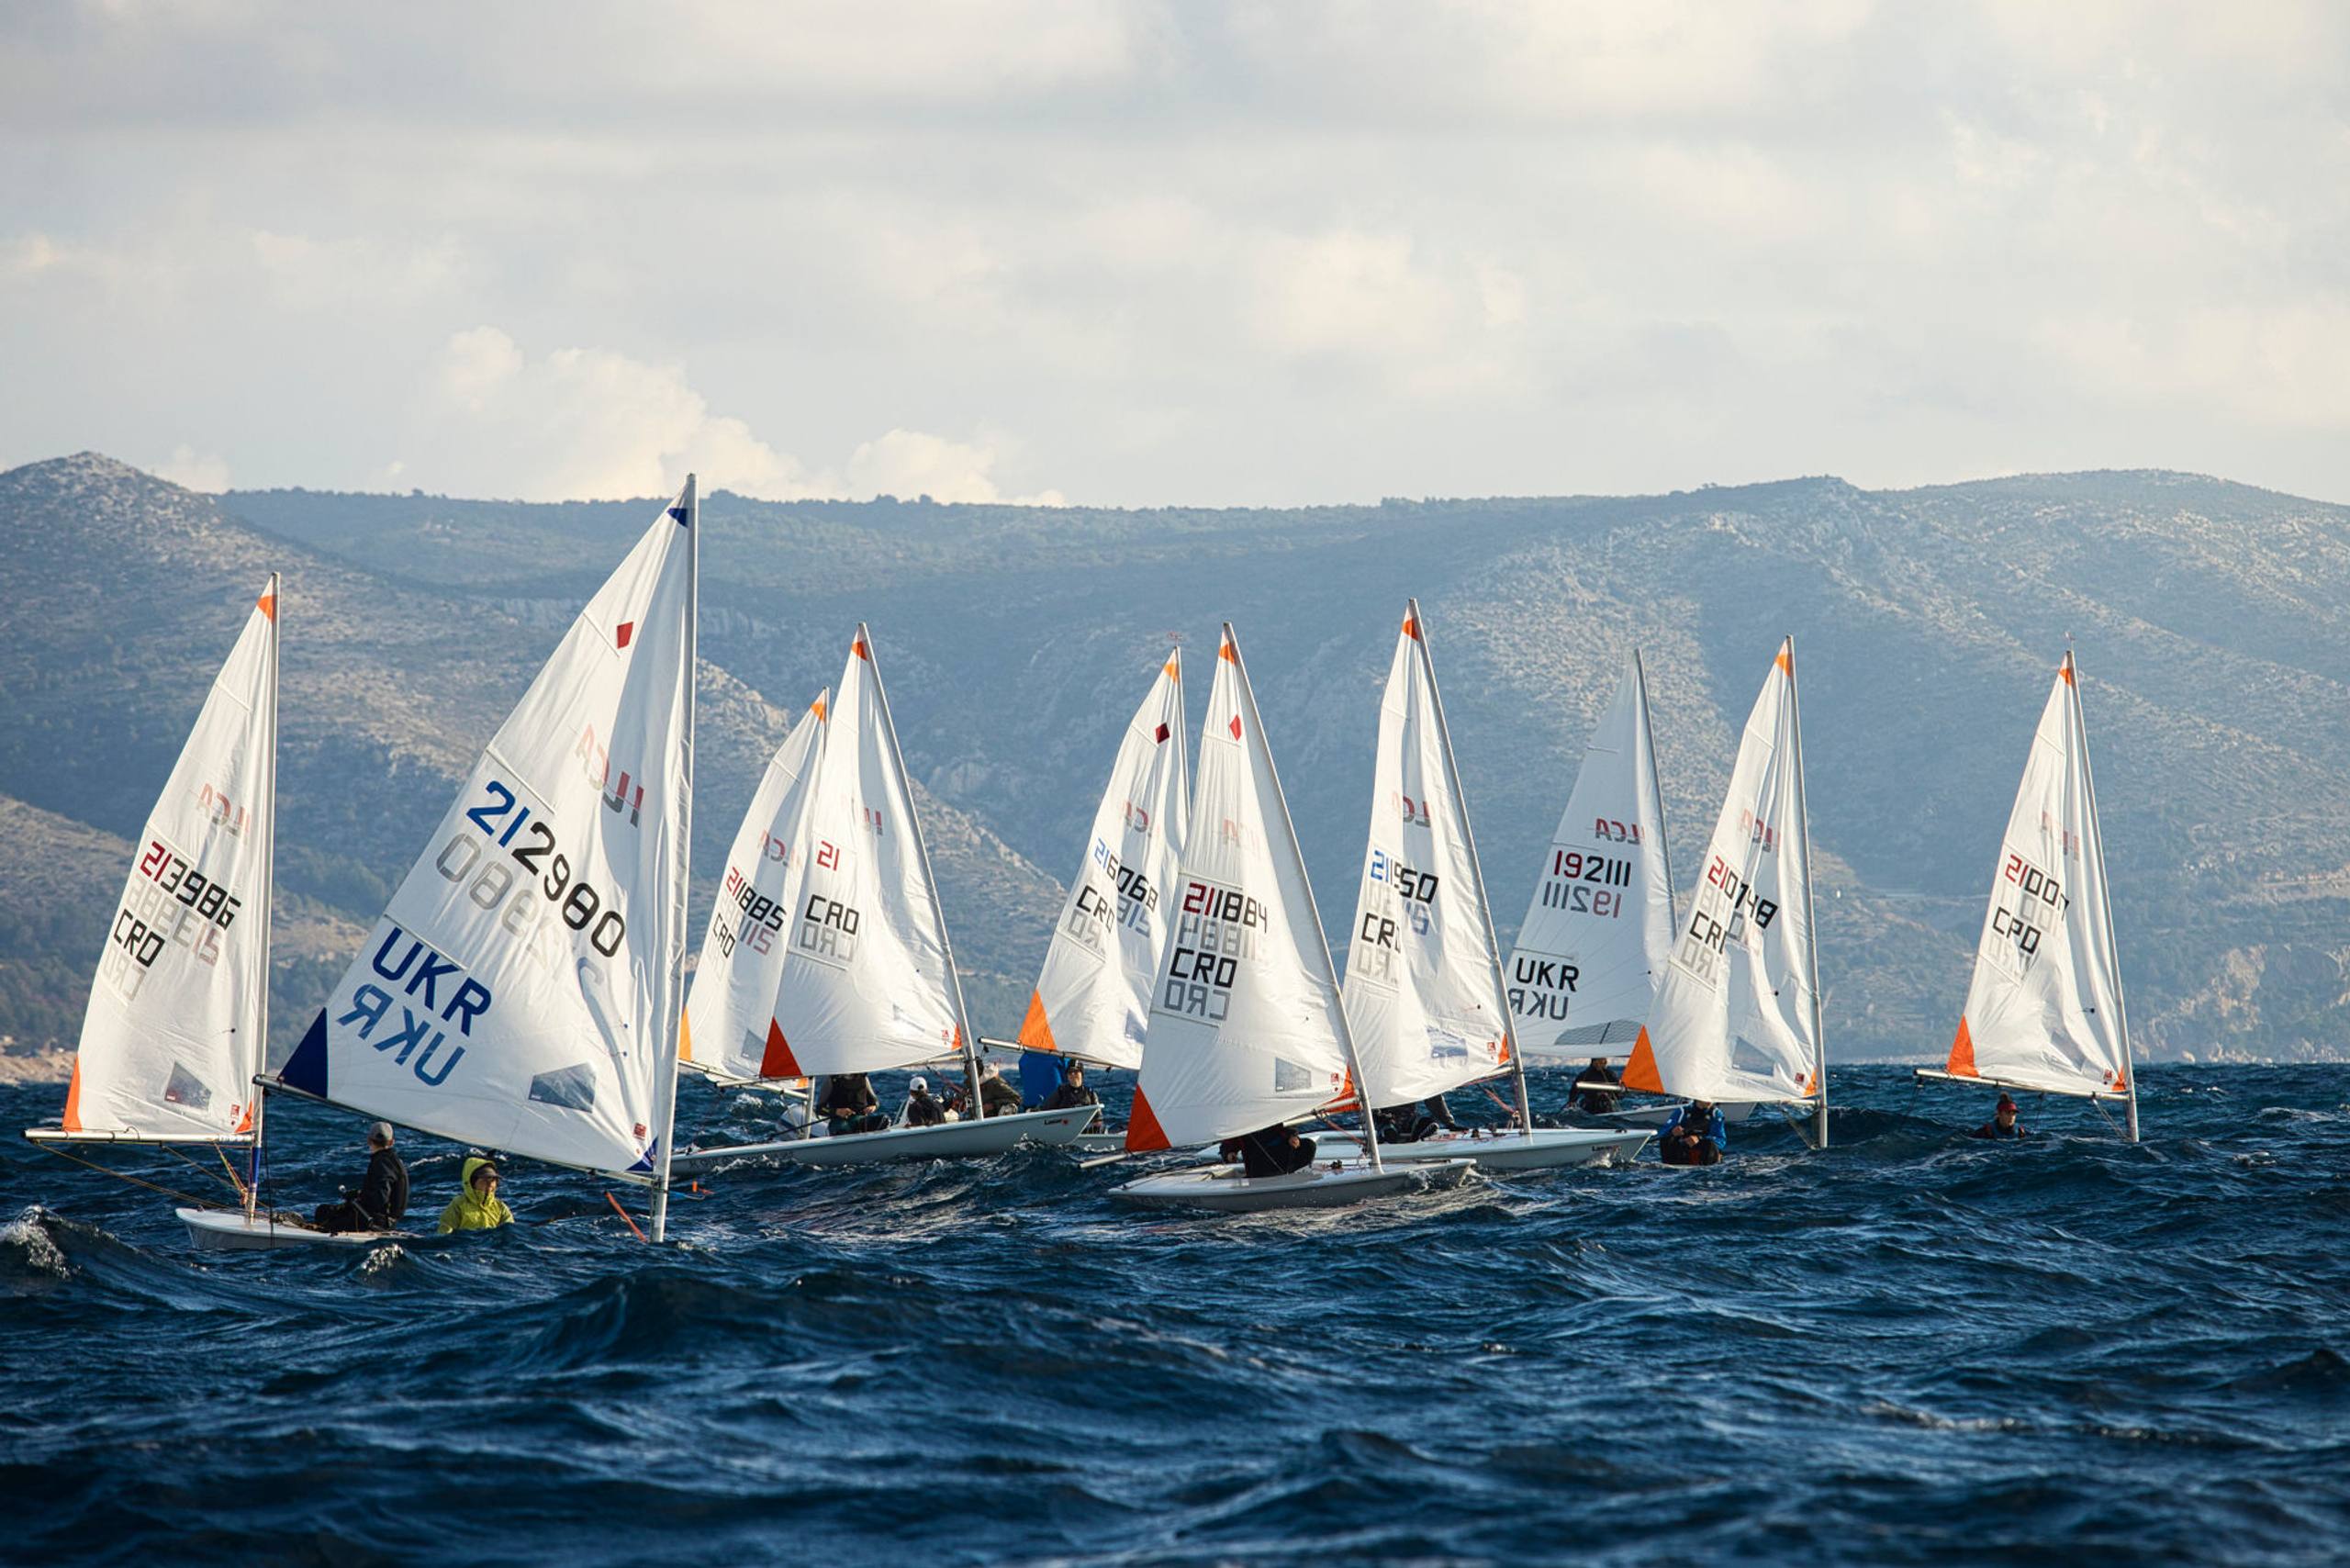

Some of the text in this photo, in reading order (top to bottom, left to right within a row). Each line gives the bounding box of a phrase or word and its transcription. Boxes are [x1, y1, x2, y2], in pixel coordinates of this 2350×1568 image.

[466, 780, 625, 957] 212980
[817, 840, 840, 871] 21
[1094, 837, 1158, 913] 216068
[1553, 850, 1631, 887] 192111
[140, 841, 241, 930] 213986
[726, 867, 787, 932] 211885
[1077, 885, 1115, 934] CRO
[1182, 882, 1267, 935] 211884
[114, 909, 165, 968] CRO
[712, 913, 735, 958] CRO
[805, 894, 860, 935] CRO
[372, 926, 491, 1036] UKR
[1169, 947, 1237, 988] CRO
[1516, 957, 1580, 992] UKR
